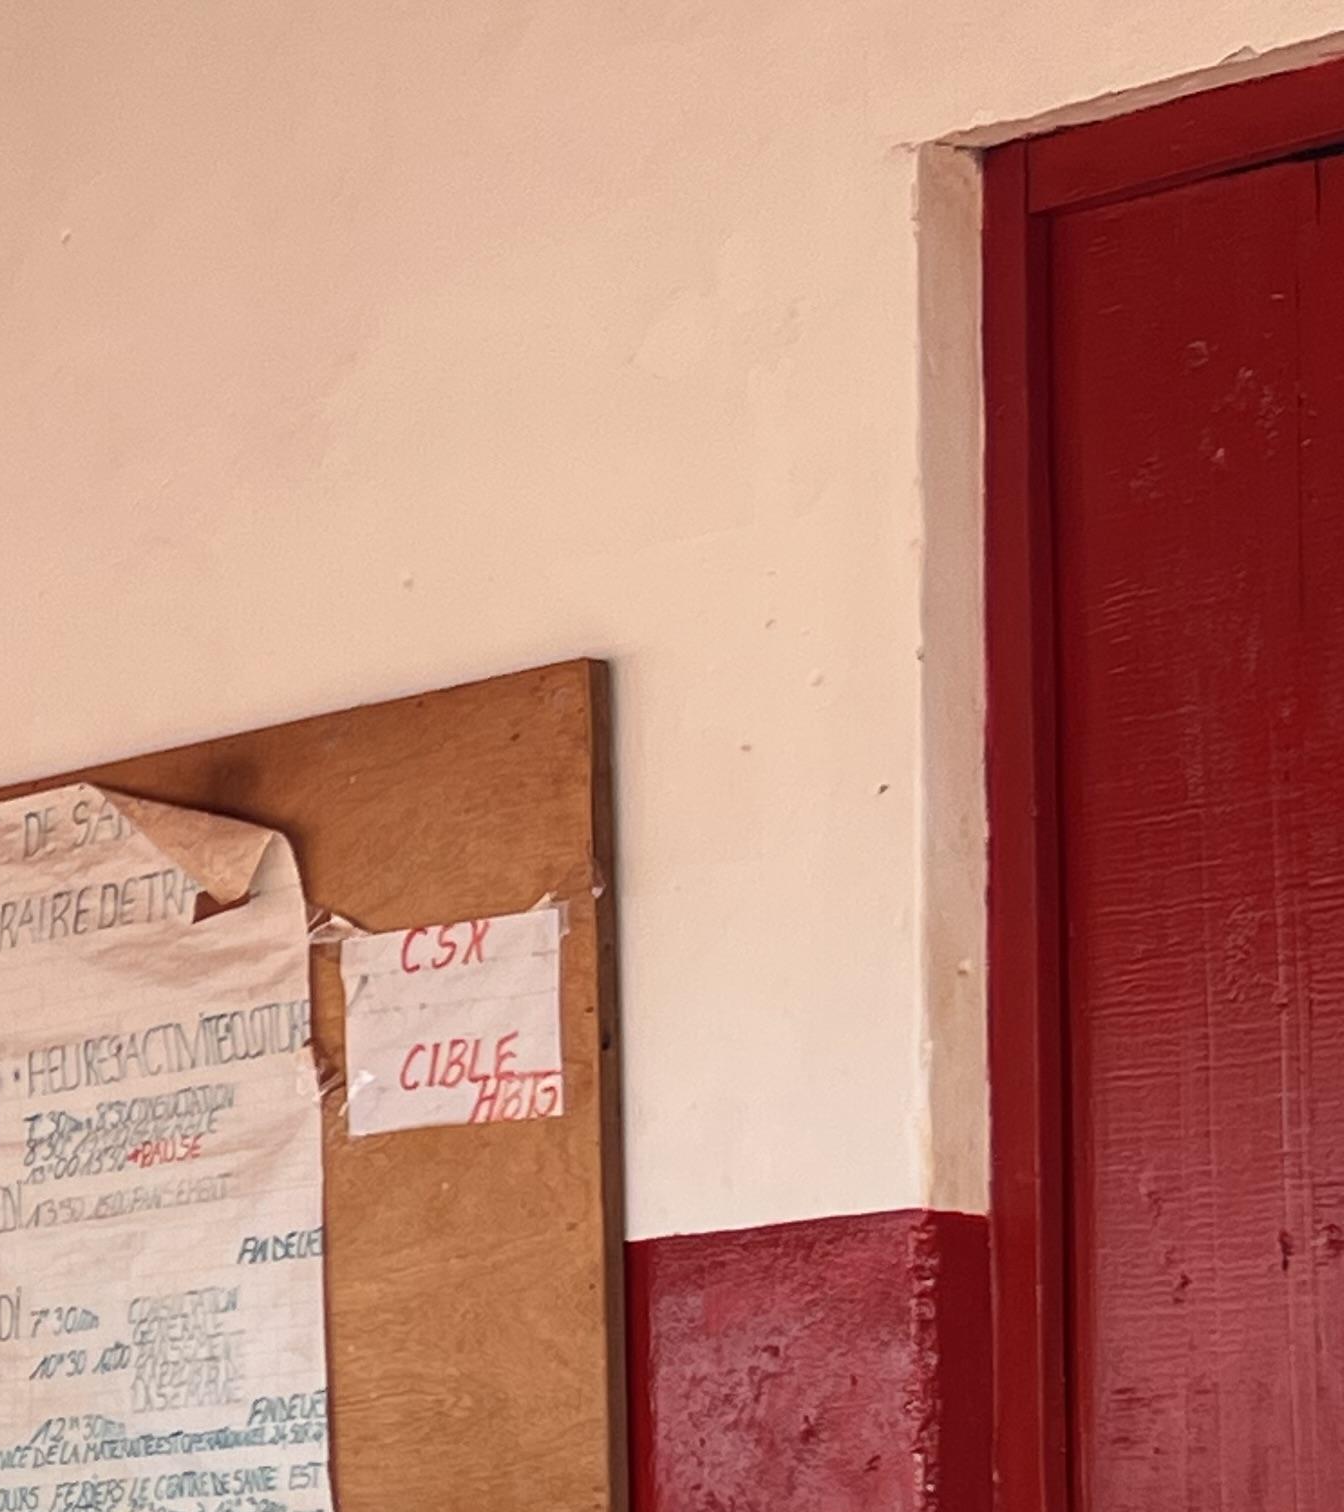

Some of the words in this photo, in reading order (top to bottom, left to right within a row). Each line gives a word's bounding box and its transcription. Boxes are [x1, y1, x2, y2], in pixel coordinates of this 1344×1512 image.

[23, 808, 60, 858] DE
[399, 1031, 518, 1090] CIBLE
[288, 1462, 323, 1491] EST
